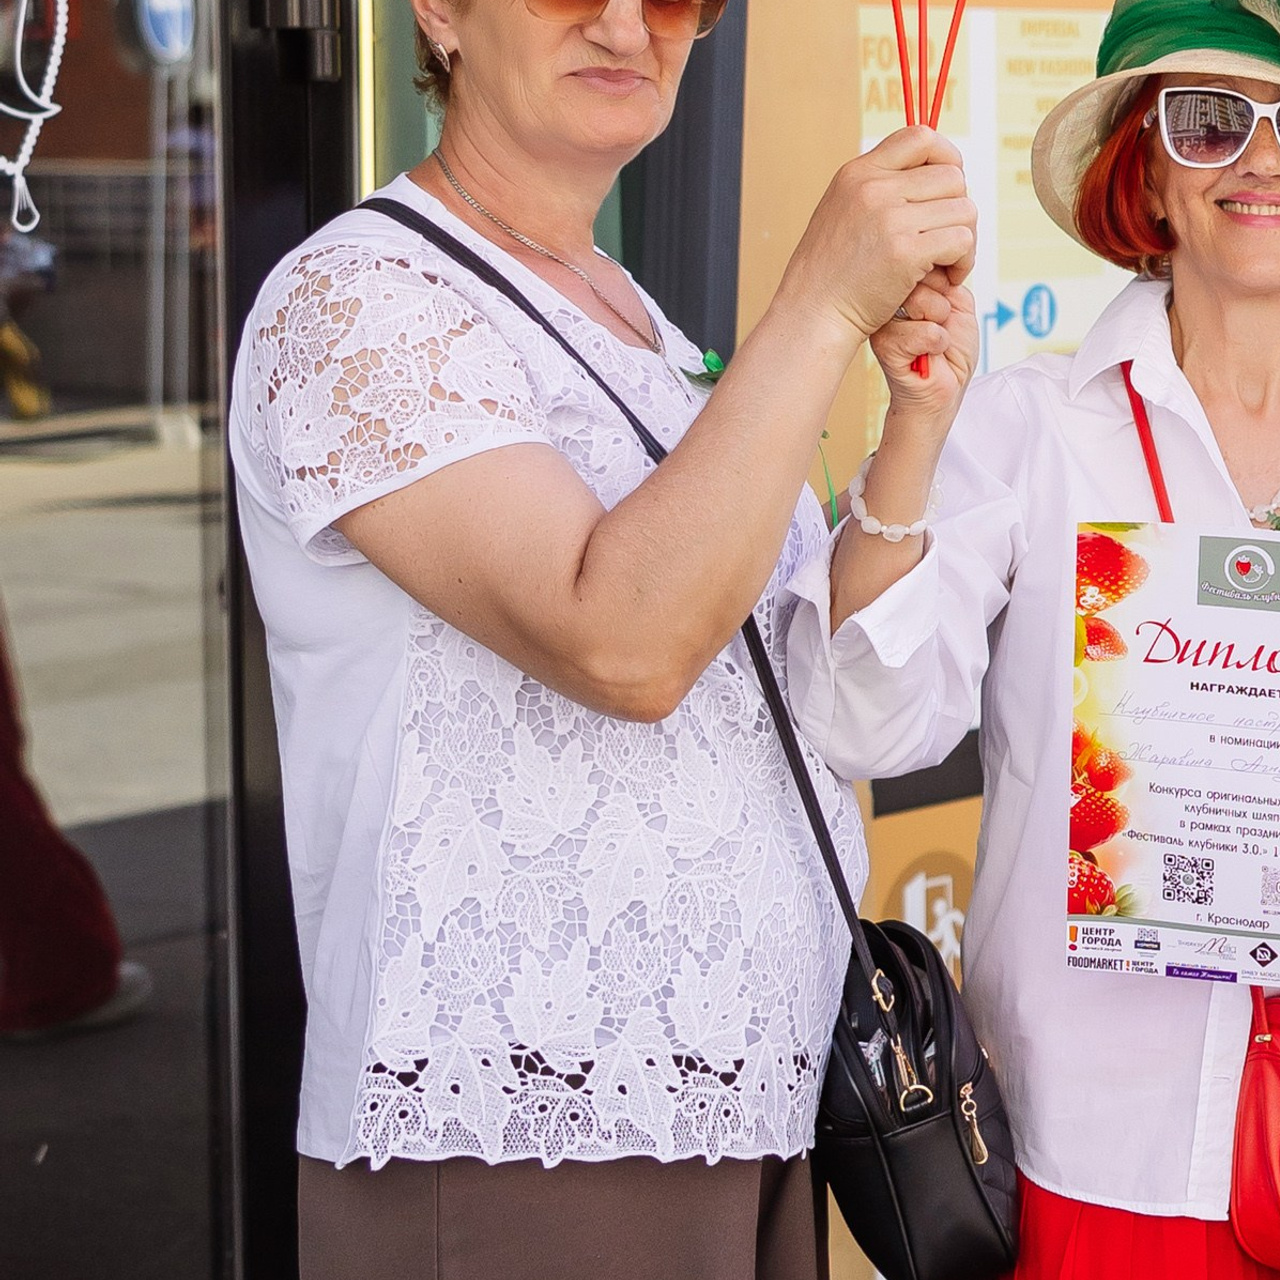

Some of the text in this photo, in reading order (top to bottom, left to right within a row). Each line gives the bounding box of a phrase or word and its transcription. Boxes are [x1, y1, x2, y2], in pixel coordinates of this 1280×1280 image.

[1201, 581, 1251, 600] Фестиваль
[1209, 734, 1215, 743] в
[1149, 782, 1201, 799] Конкурса
[1184, 803, 1247, 819] клубничных
[1190, 822, 1231, 834] рамках
[1122, 828, 1184, 847] «Фестиваль
[1188, 837, 1238, 854] клубники
[1242, 842, 1268, 856] 3.0.»
[1207, 912, 1270, 931] Краснодар
[1081, 927, 1115, 937] ЦЕНТР
[1081, 936, 1122, 947] ГОРОДА
[1067, 956, 1124, 971] FOODMARKET
[1131, 960, 1154, 968] ЦЕНТР
[1131, 966, 1158, 974] ГОРОДА
